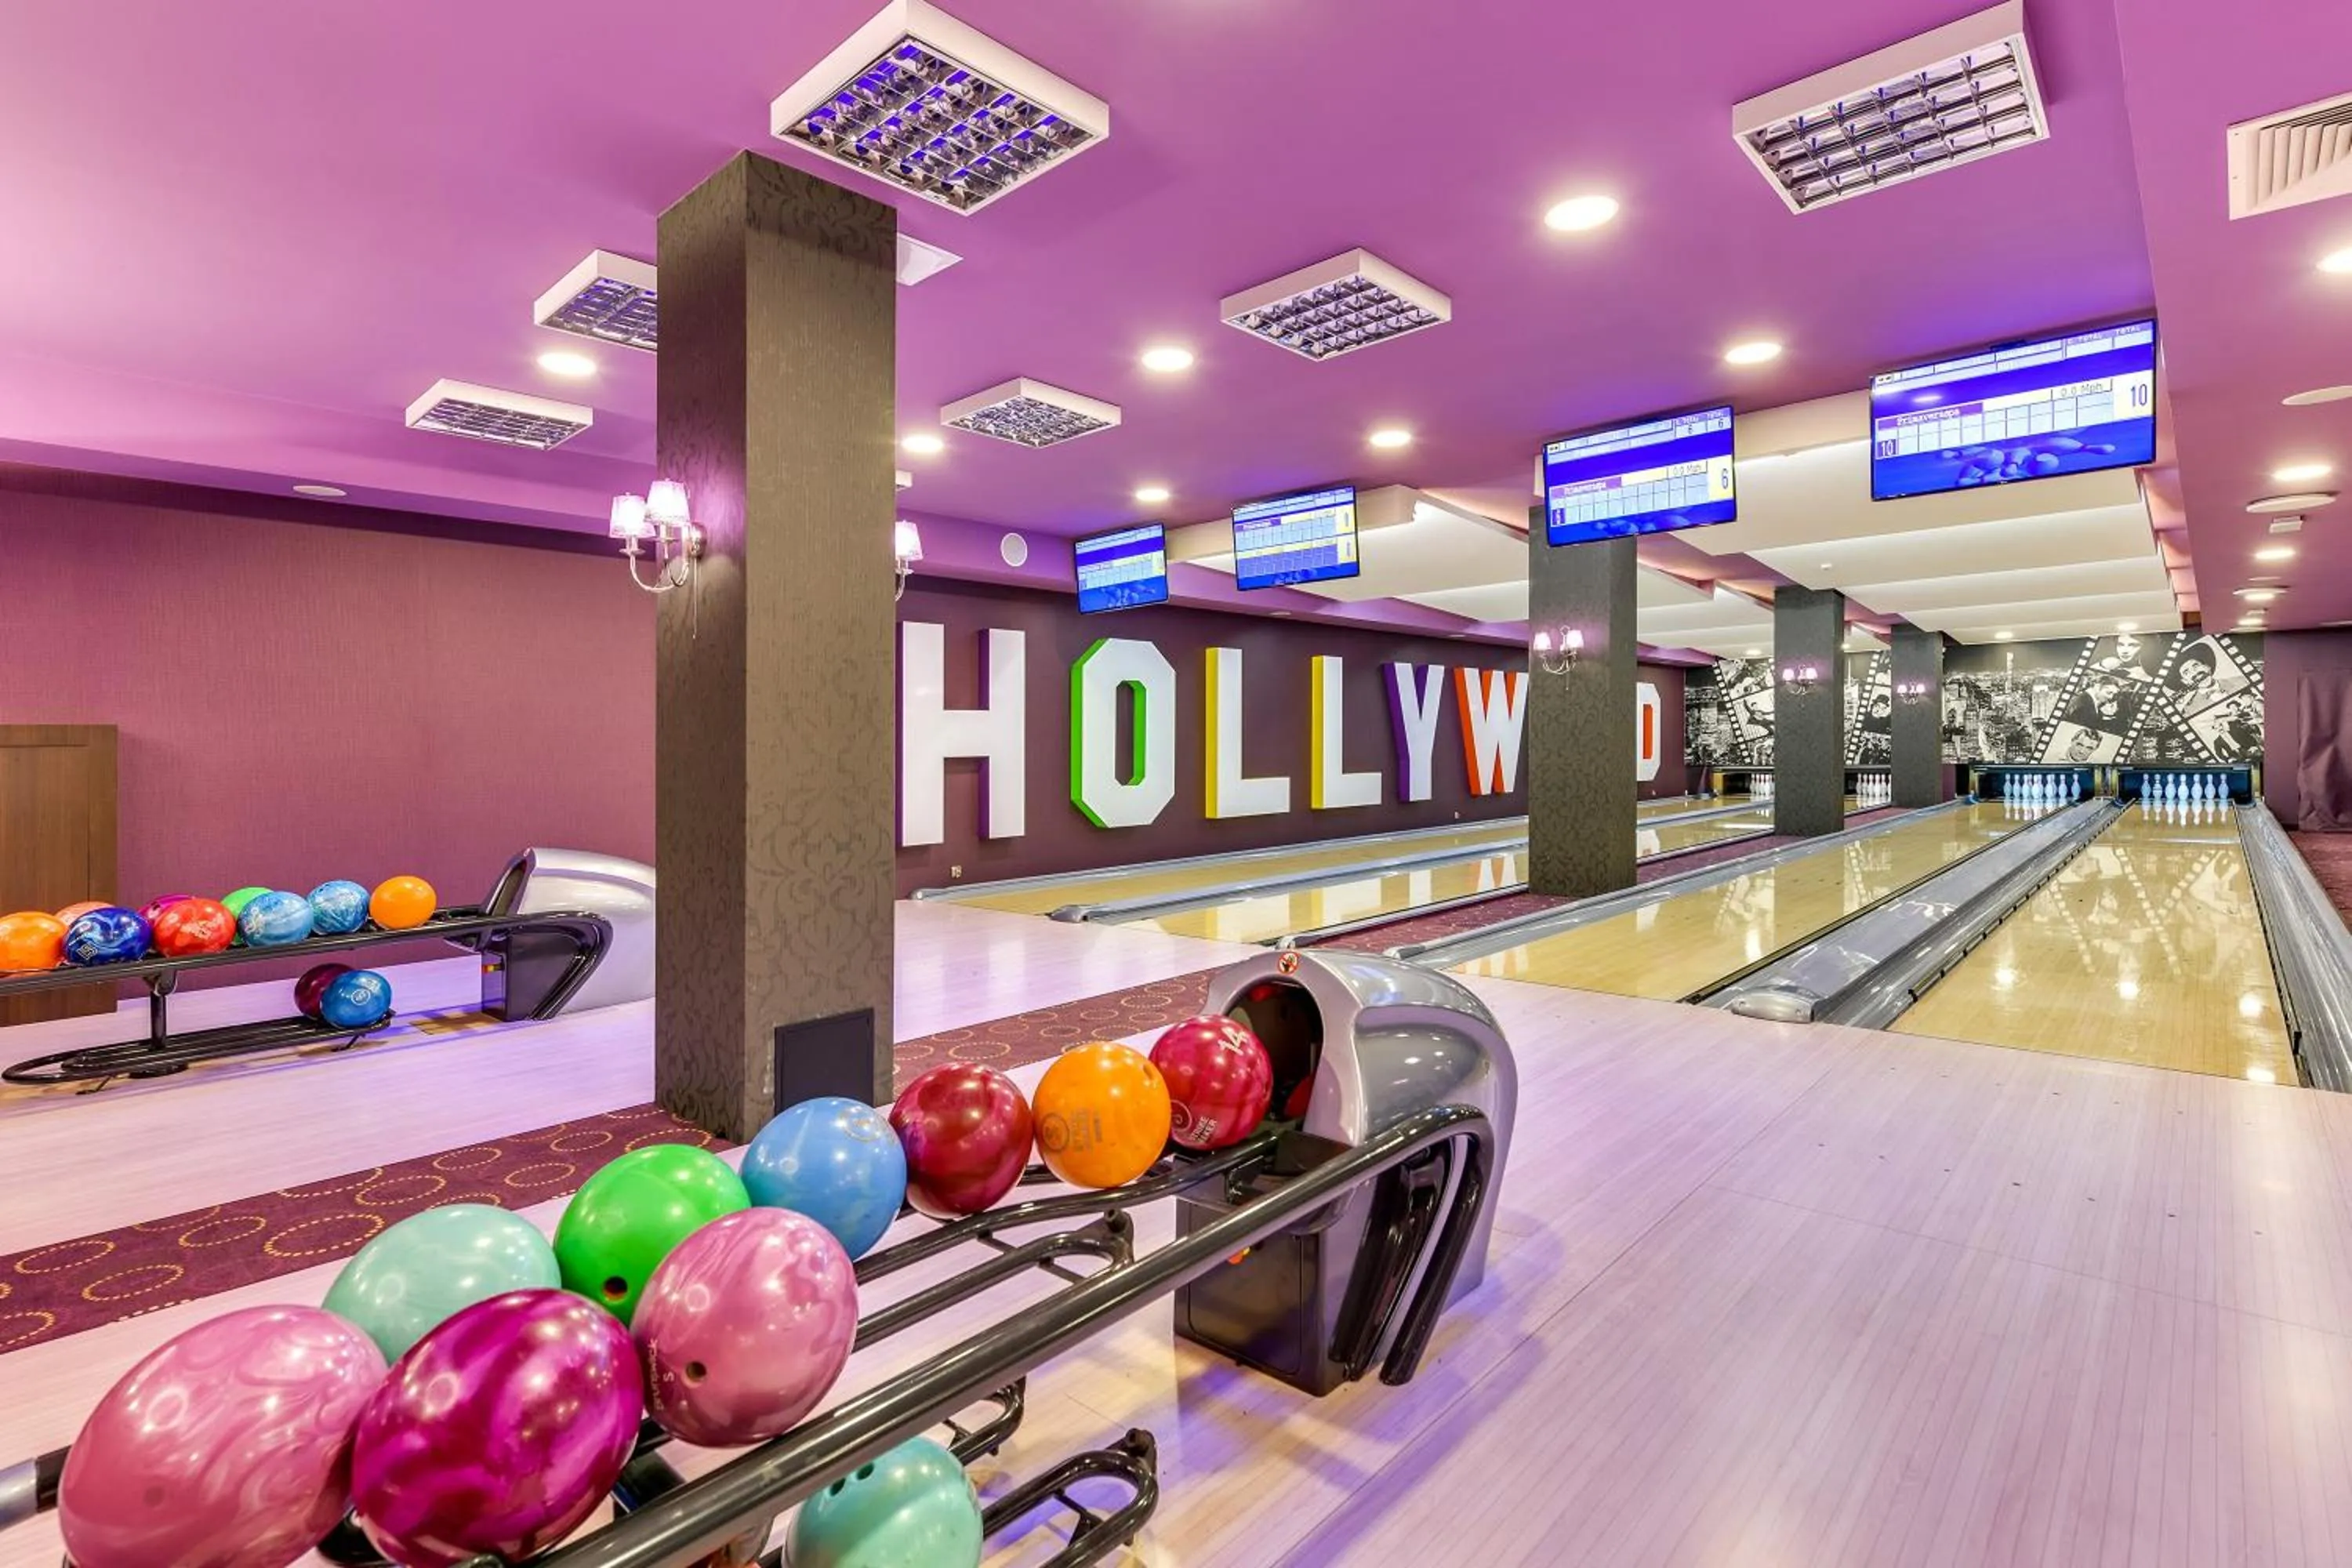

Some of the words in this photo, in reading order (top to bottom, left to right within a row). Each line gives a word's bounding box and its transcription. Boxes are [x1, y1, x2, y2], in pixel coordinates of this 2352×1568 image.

[2130, 383, 2147, 407] 10
[1881, 439, 1894, 456] 10
[1721, 467, 1729, 490] 6
[896, 620, 1661, 848] HOLLYWD
[662, 1370, 674, 1382] S
